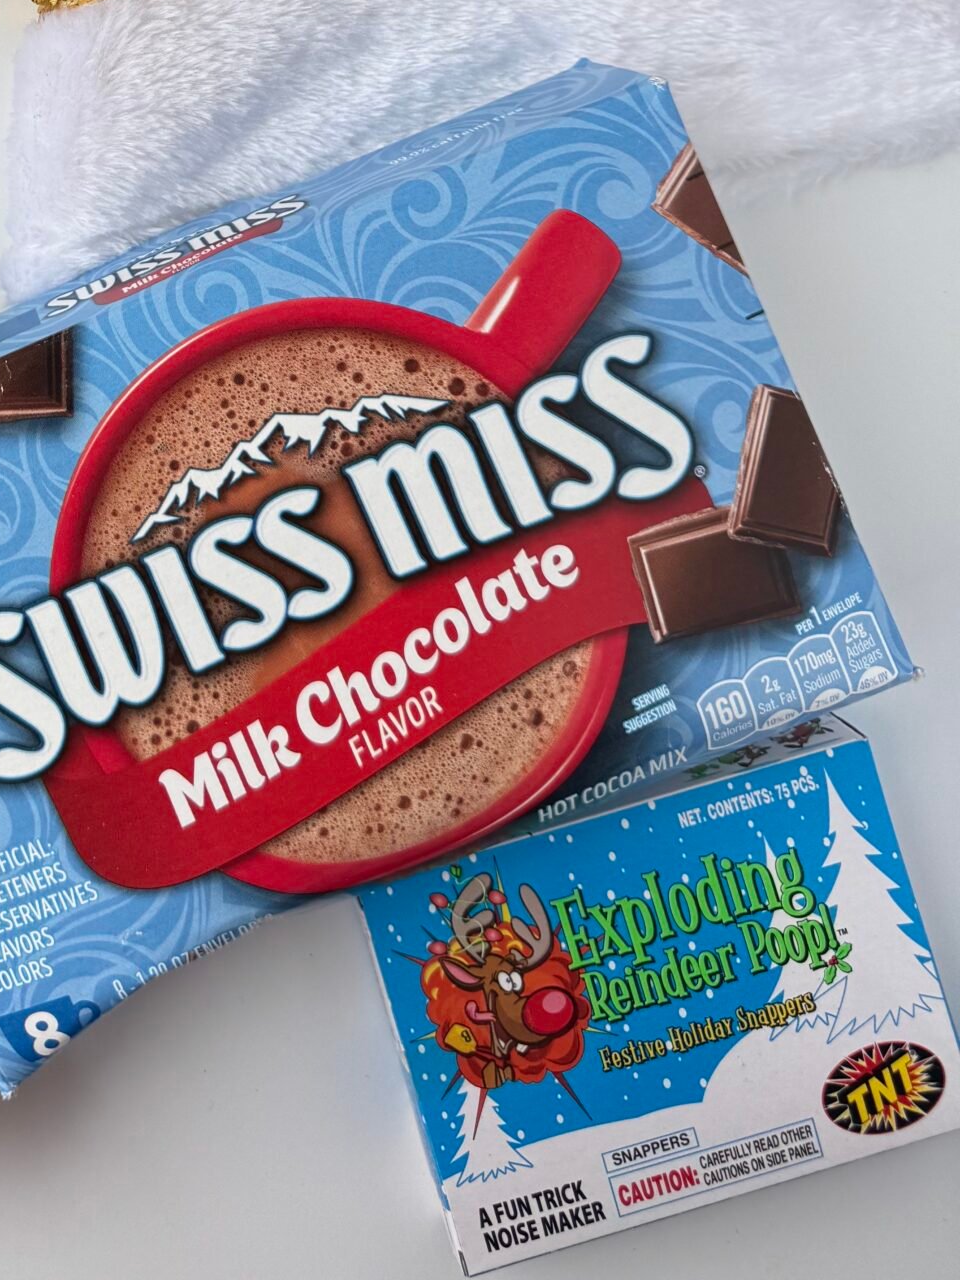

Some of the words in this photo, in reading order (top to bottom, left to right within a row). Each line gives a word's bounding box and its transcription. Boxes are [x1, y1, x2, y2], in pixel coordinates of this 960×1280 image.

[121, 273, 158, 293] Milk
[160, 232, 243, 276] Chocolate
[794, 618, 815, 636] PER
[808, 606, 824, 627] 1
[822, 591, 863, 623] ENVELOPE
[840, 616, 868, 645] 23g
[793, 648, 837, 679] 170mg
[845, 635, 877, 660] Added
[848, 648, 884, 675] Sugars
[158, 729, 302, 830] Milk
[295, 543, 580, 747] Chocolate
[631, 683, 671, 711] SERVING
[757, 698, 779, 717] Sat.
[779, 688, 798, 706] Fat
[760, 674, 782, 696] 2g
[804, 669, 841, 695] Sodium
[858, 676, 879, 692] 46%
[876, 669, 890, 683] DV
[347, 685, 443, 767] FLAVOR
[622, 700, 678, 735] SUGGESTION
[705, 690, 748, 730] 160
[712, 719, 754, 743] Calories
[538, 794, 578, 823] HOT
[581, 766, 646, 805] COCOA
[649, 746, 689, 778] MIX
[677, 809, 708, 829] NET.
[707, 788, 776, 822] CONTENTS:
[773, 782, 791, 801] 75
[790, 774, 820, 796] PCS.
[550, 846, 816, 971] Exploding
[581, 943, 737, 1022] Reindeer
[24, 1011, 71, 1056] 8
[599, 1038, 668, 1072] Festive
[668, 1017, 735, 1053] Holiday
[735, 992, 817, 1033] Snappers
[846, 1051, 914, 1125] TNT
[611, 1133, 691, 1166] SNAPPERS
[699, 1141, 753, 1170] CAREFULLY
[752, 1135, 779, 1155] READ
[780, 1124, 813, 1147] OTHER
[703, 1160, 750, 1186] CAUTIONS
[750, 1156, 766, 1173] ON
[766, 1150, 789, 1167] SIDE
[789, 1141, 819, 1162] PANEL
[478, 1206, 493, 1229] A
[493, 1197, 533, 1226] FUN
[533, 1180, 588, 1215] TRICK
[617, 1166, 701, 1207] CAUTION:
[483, 1220, 541, 1253] NOISE
[543, 1201, 607, 1238] MAKER
